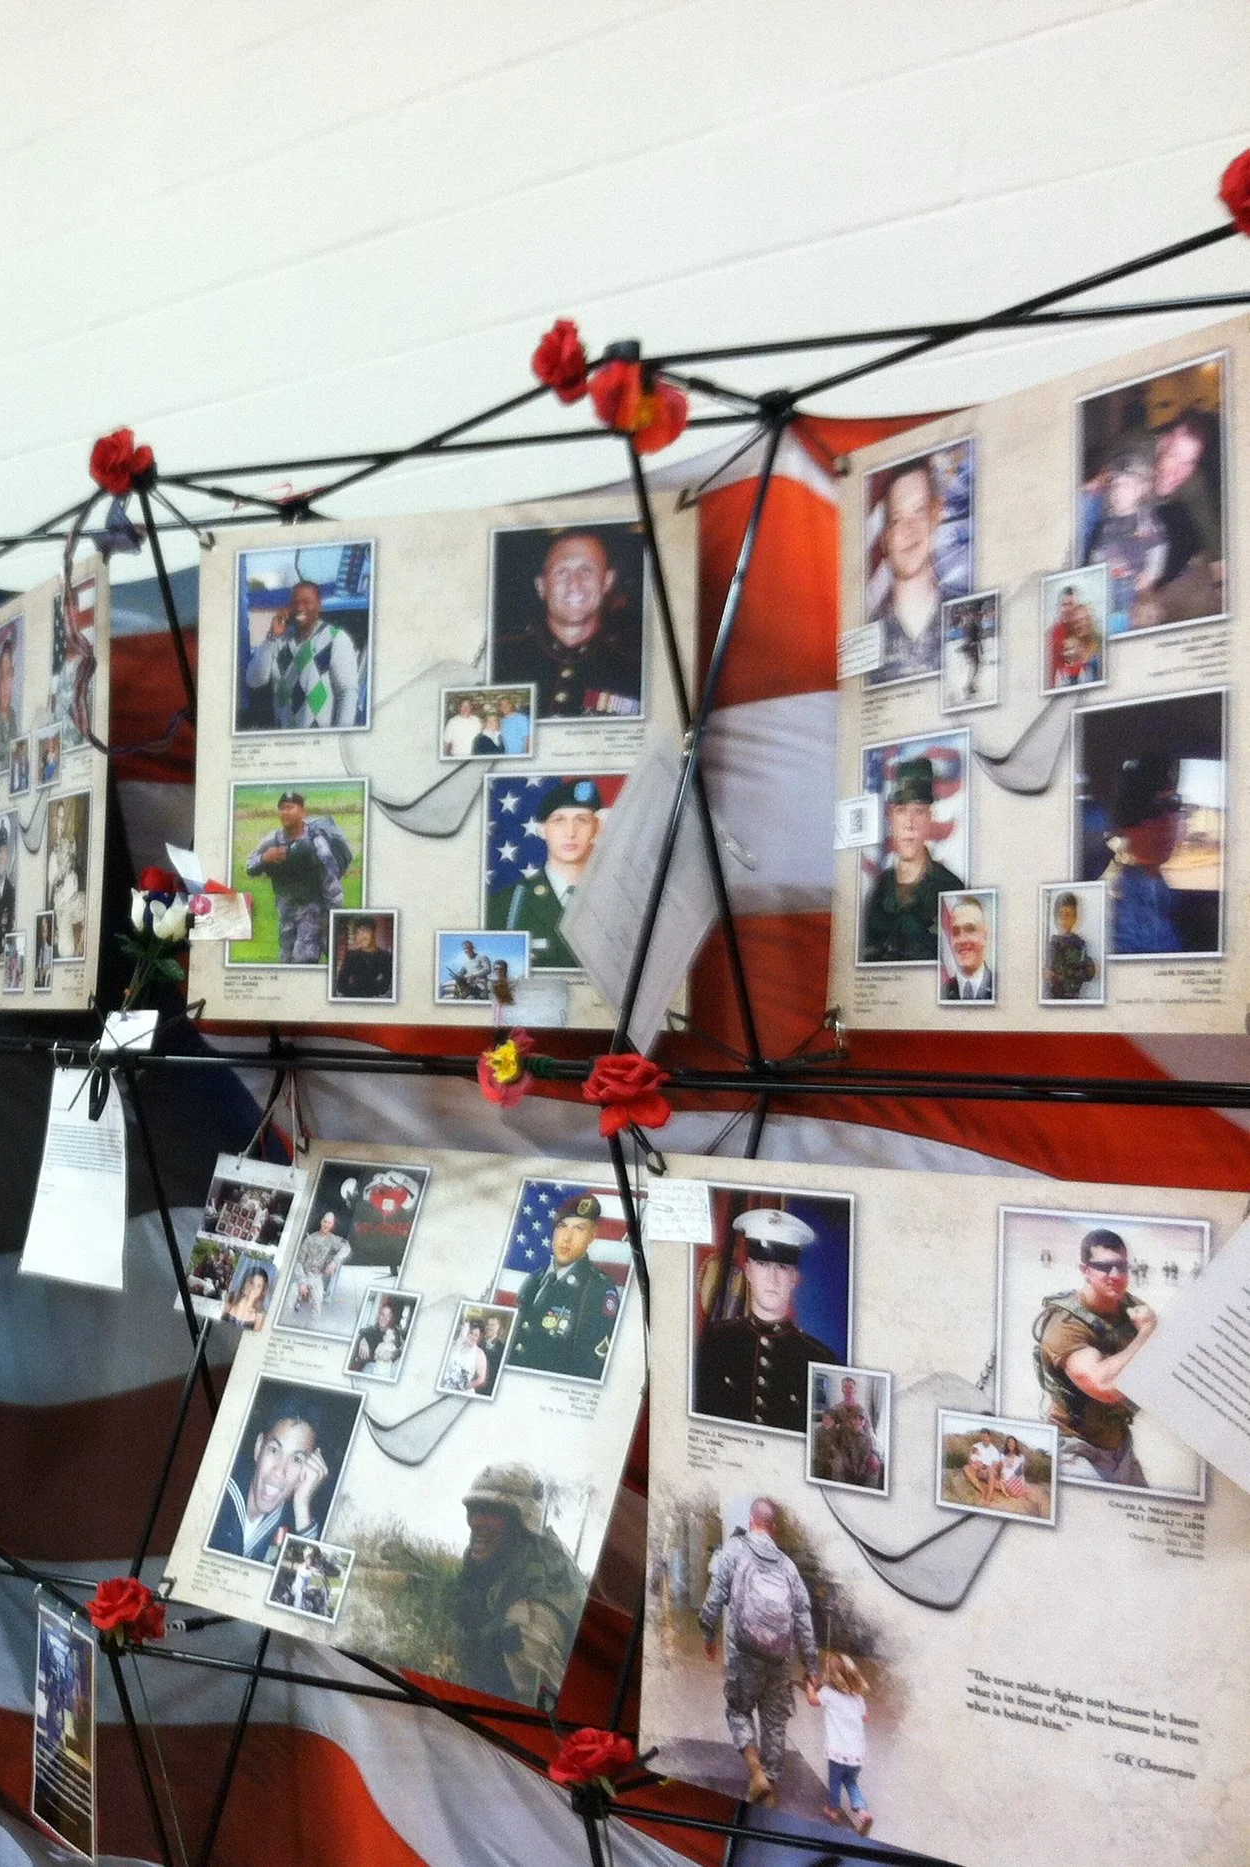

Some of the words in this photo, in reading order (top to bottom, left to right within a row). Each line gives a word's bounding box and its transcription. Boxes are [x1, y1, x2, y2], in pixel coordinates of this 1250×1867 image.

[966, 1700, 991, 1714] what
[993, 1705, 1001, 1717] is
[1003, 1708, 1039, 1726] behind
[966, 1685, 991, 1699] what
[993, 1689, 1002, 1701] is
[1004, 1692, 1015, 1704] in
[1017, 1695, 1044, 1711] front
[1045, 1703, 1059, 1714] of
[1086, 1710, 1106, 1725] but
[1108, 1715, 1150, 1735] because
[1153, 1725, 1168, 1739] he
[1170, 1729, 1199, 1746] loves
[993, 1676, 1015, 1689] true
[1016, 1681, 1052, 1697] soldier
[1054, 1687, 1083, 1704] fights
[1086, 1697, 1105, 1709] not
[1107, 1700, 1150, 1719] because
[1153, 1708, 1167, 1722] he
[1170, 1712, 1199, 1729] hates
